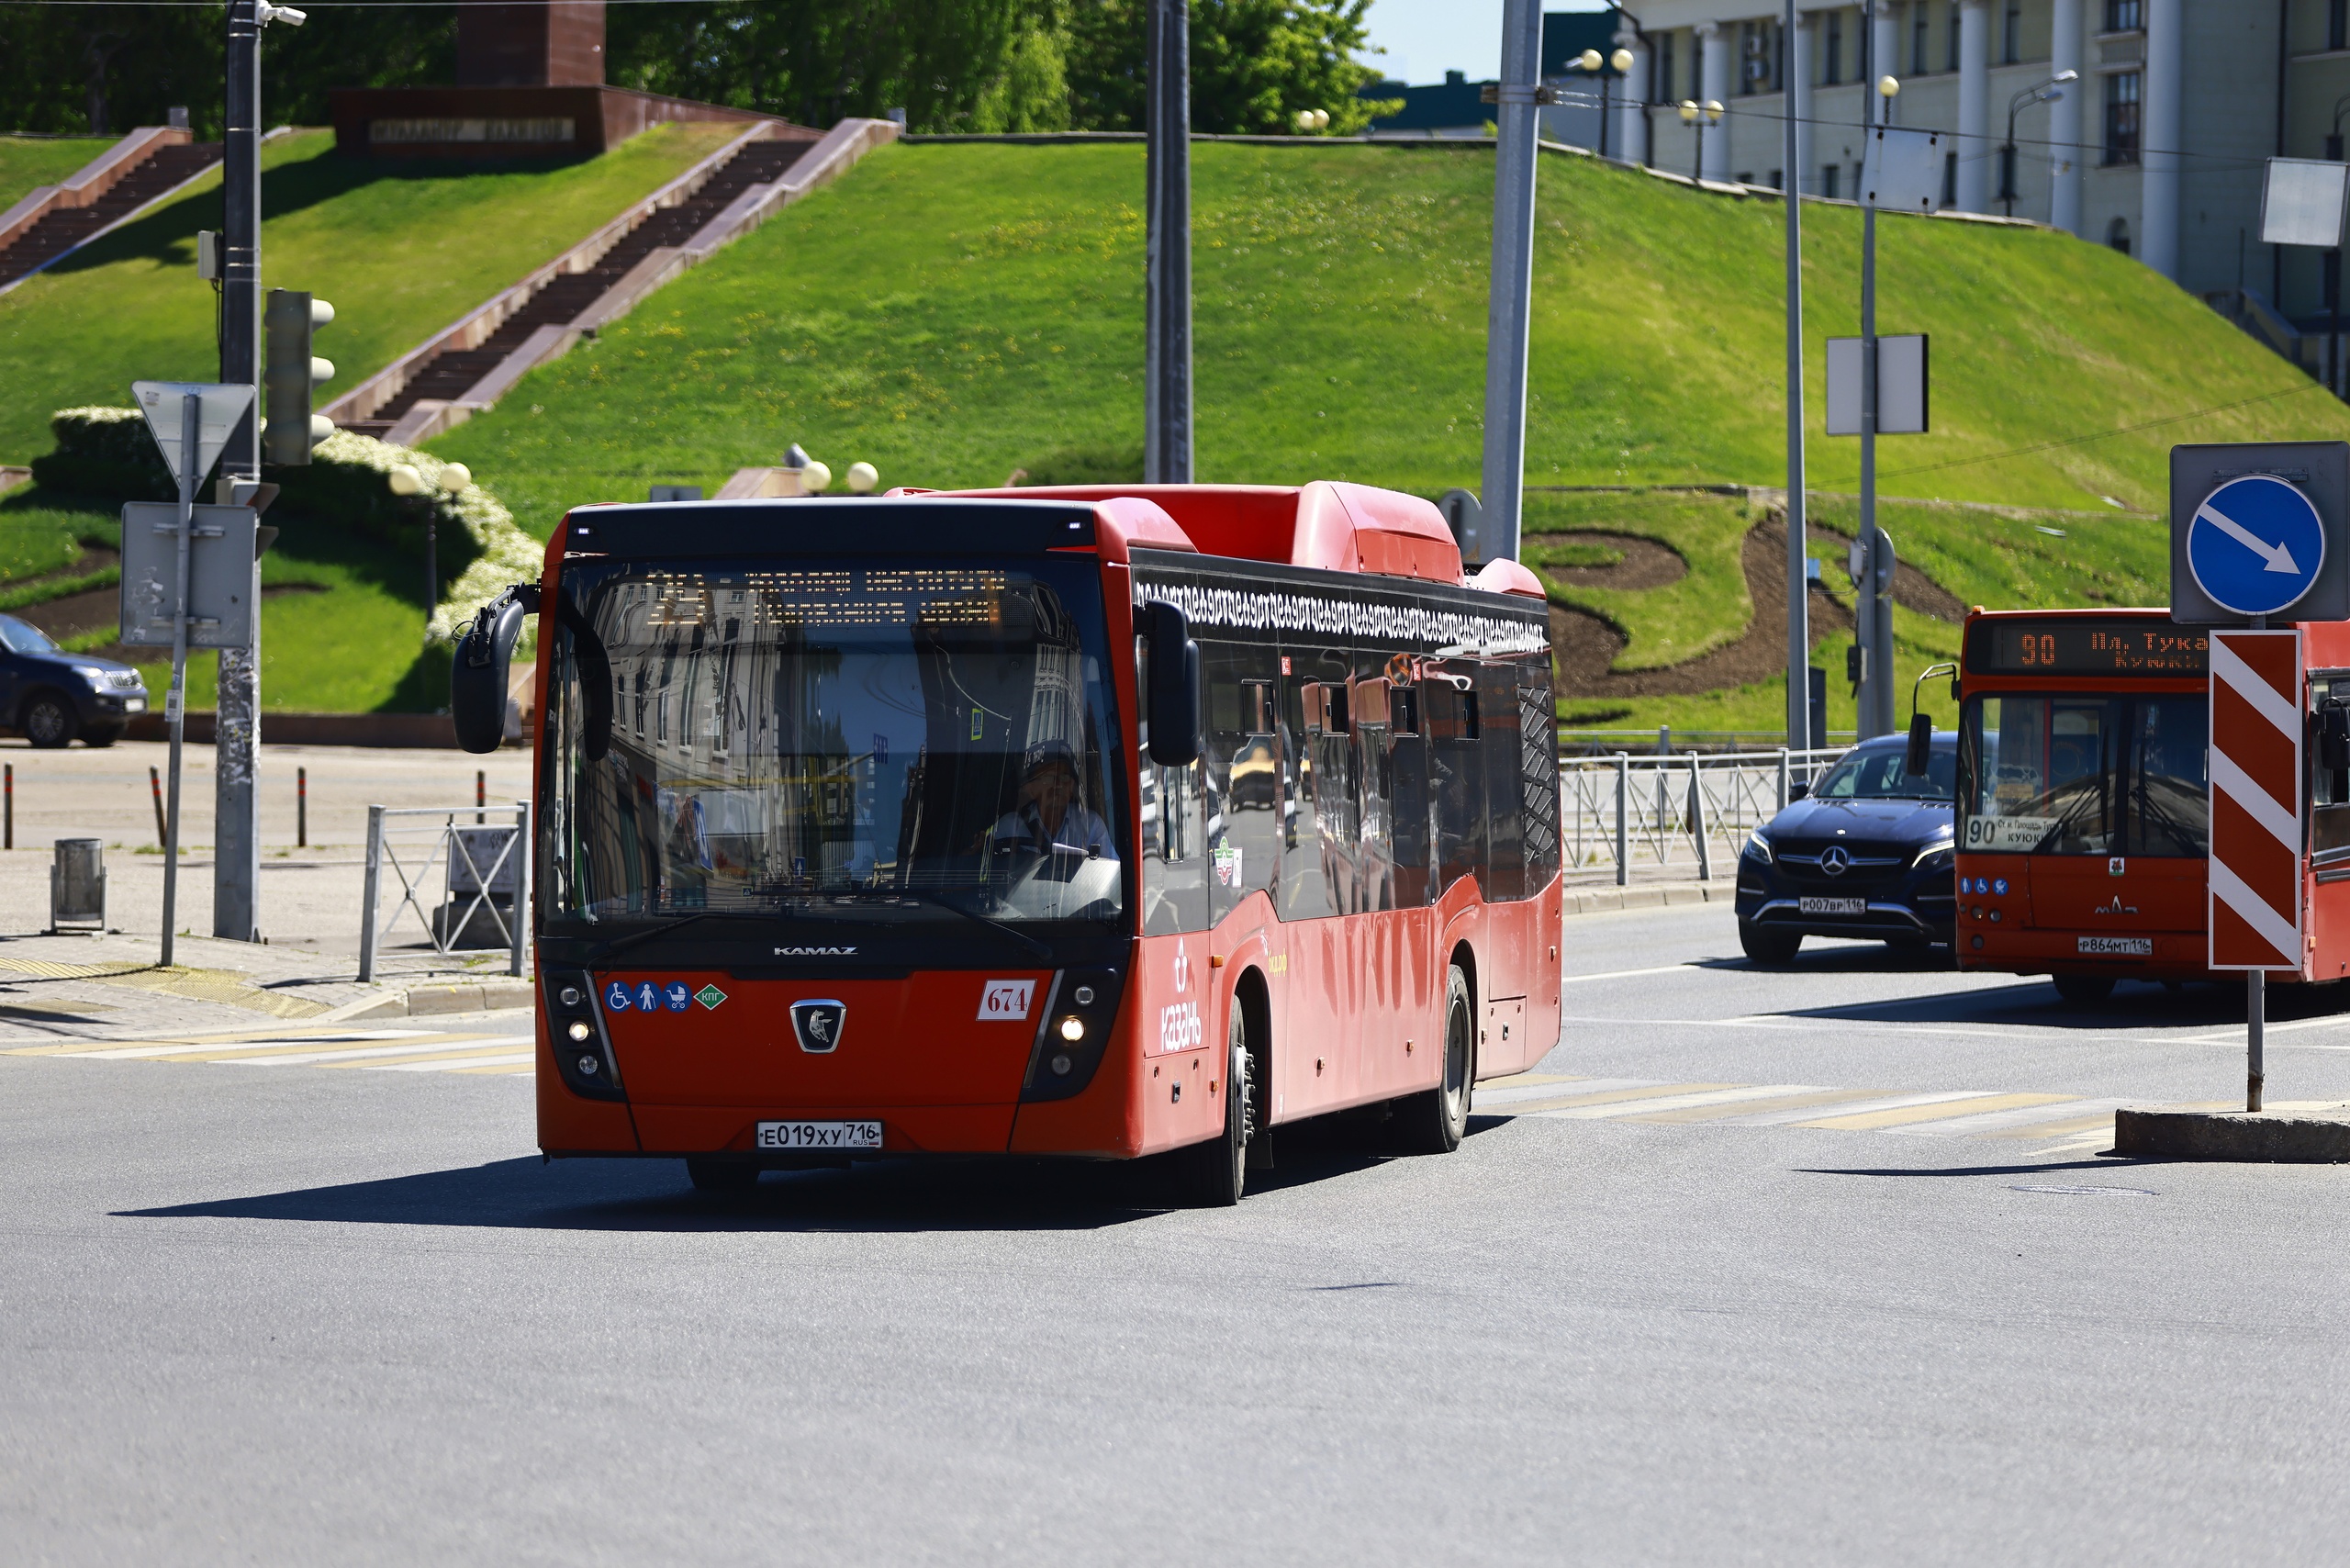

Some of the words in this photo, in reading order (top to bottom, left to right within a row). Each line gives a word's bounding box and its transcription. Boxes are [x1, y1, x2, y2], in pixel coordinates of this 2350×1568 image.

[2021, 633, 2055, 666] 90
[2143, 632, 2209, 653] Тука
[1969, 819, 1996, 844] 90
[774, 946, 858, 956] KAMAZ
[2131, 938, 2148, 949] 116
[701, 992, 721, 1001] КПГ
[987, 988, 1028, 1013] 674
[765, 1125, 842, 1146] Е019ХУ
[845, 1124, 877, 1140] 716
